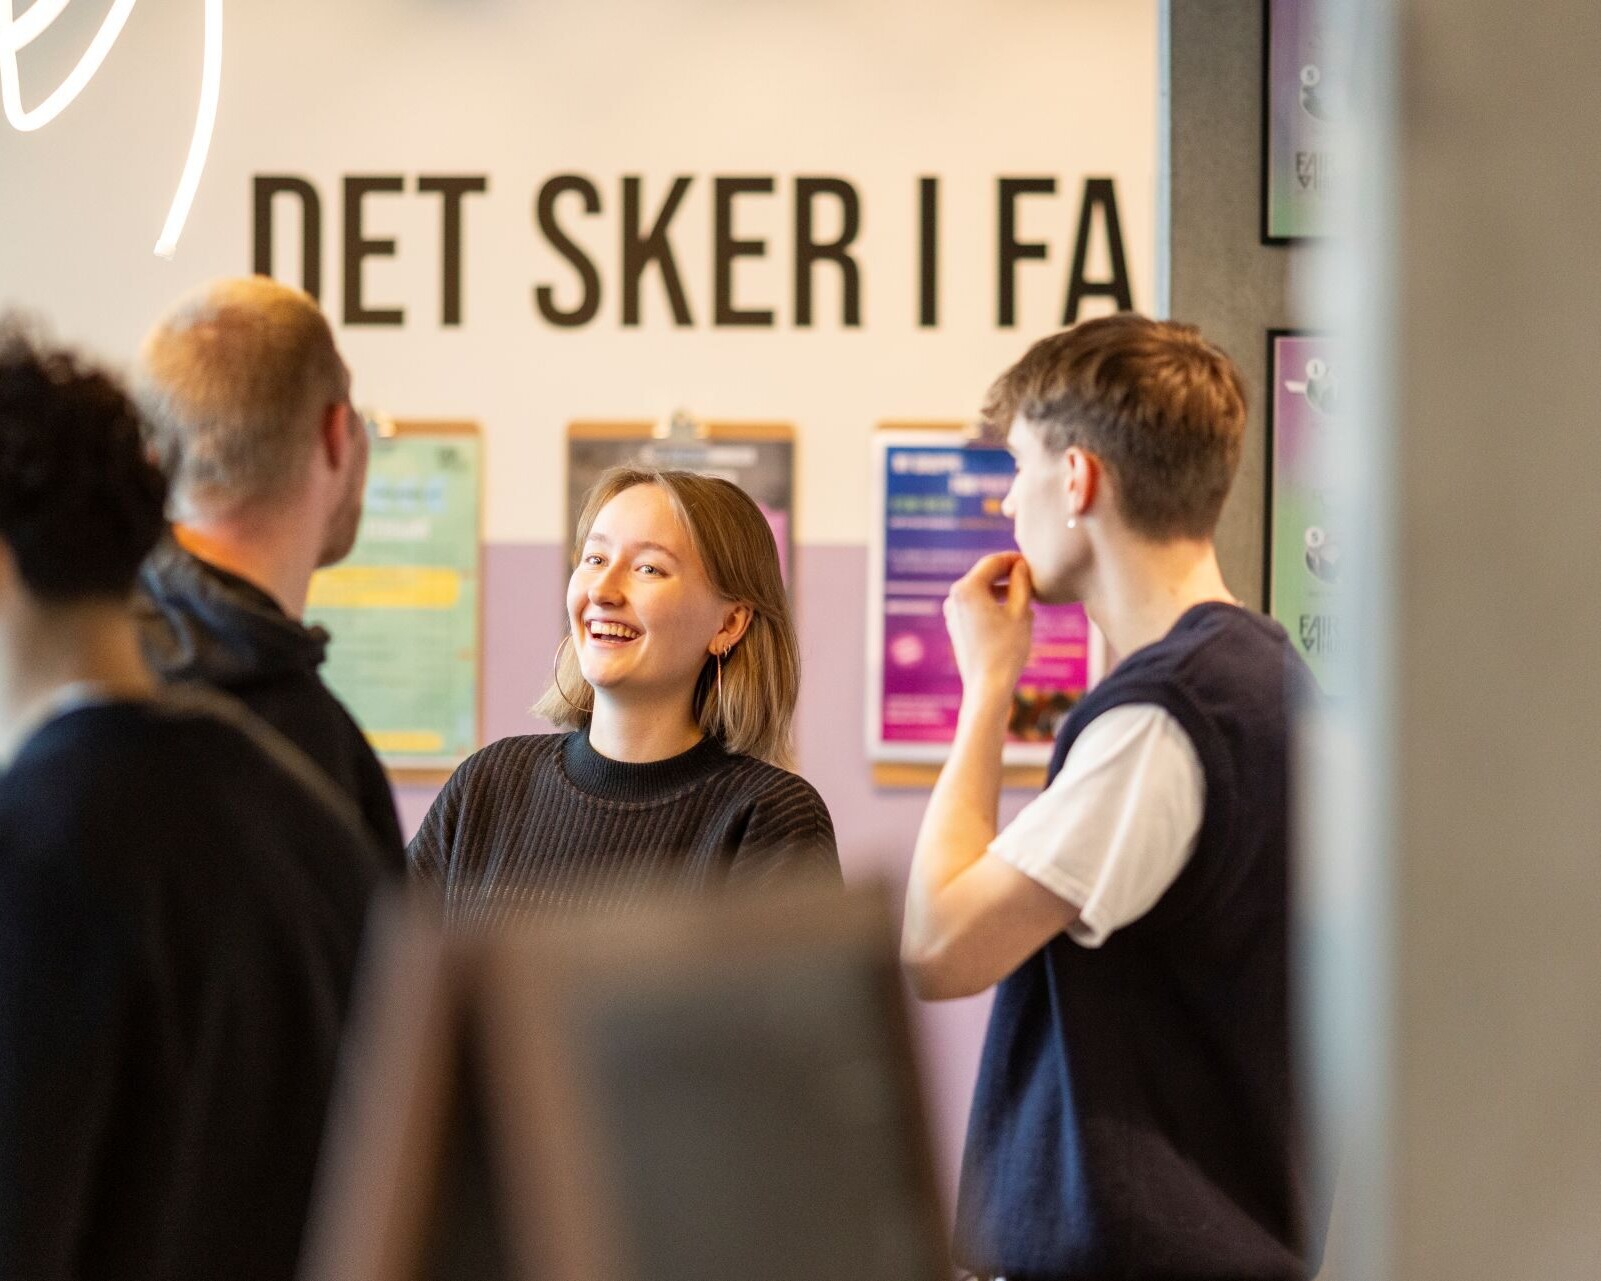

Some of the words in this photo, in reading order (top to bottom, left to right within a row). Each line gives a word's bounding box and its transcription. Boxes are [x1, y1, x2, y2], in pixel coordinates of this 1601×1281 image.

[252, 175, 487, 327] DET
[535, 174, 861, 327] SKER
[919, 177, 938, 327] I
[997, 177, 1133, 327] FA
